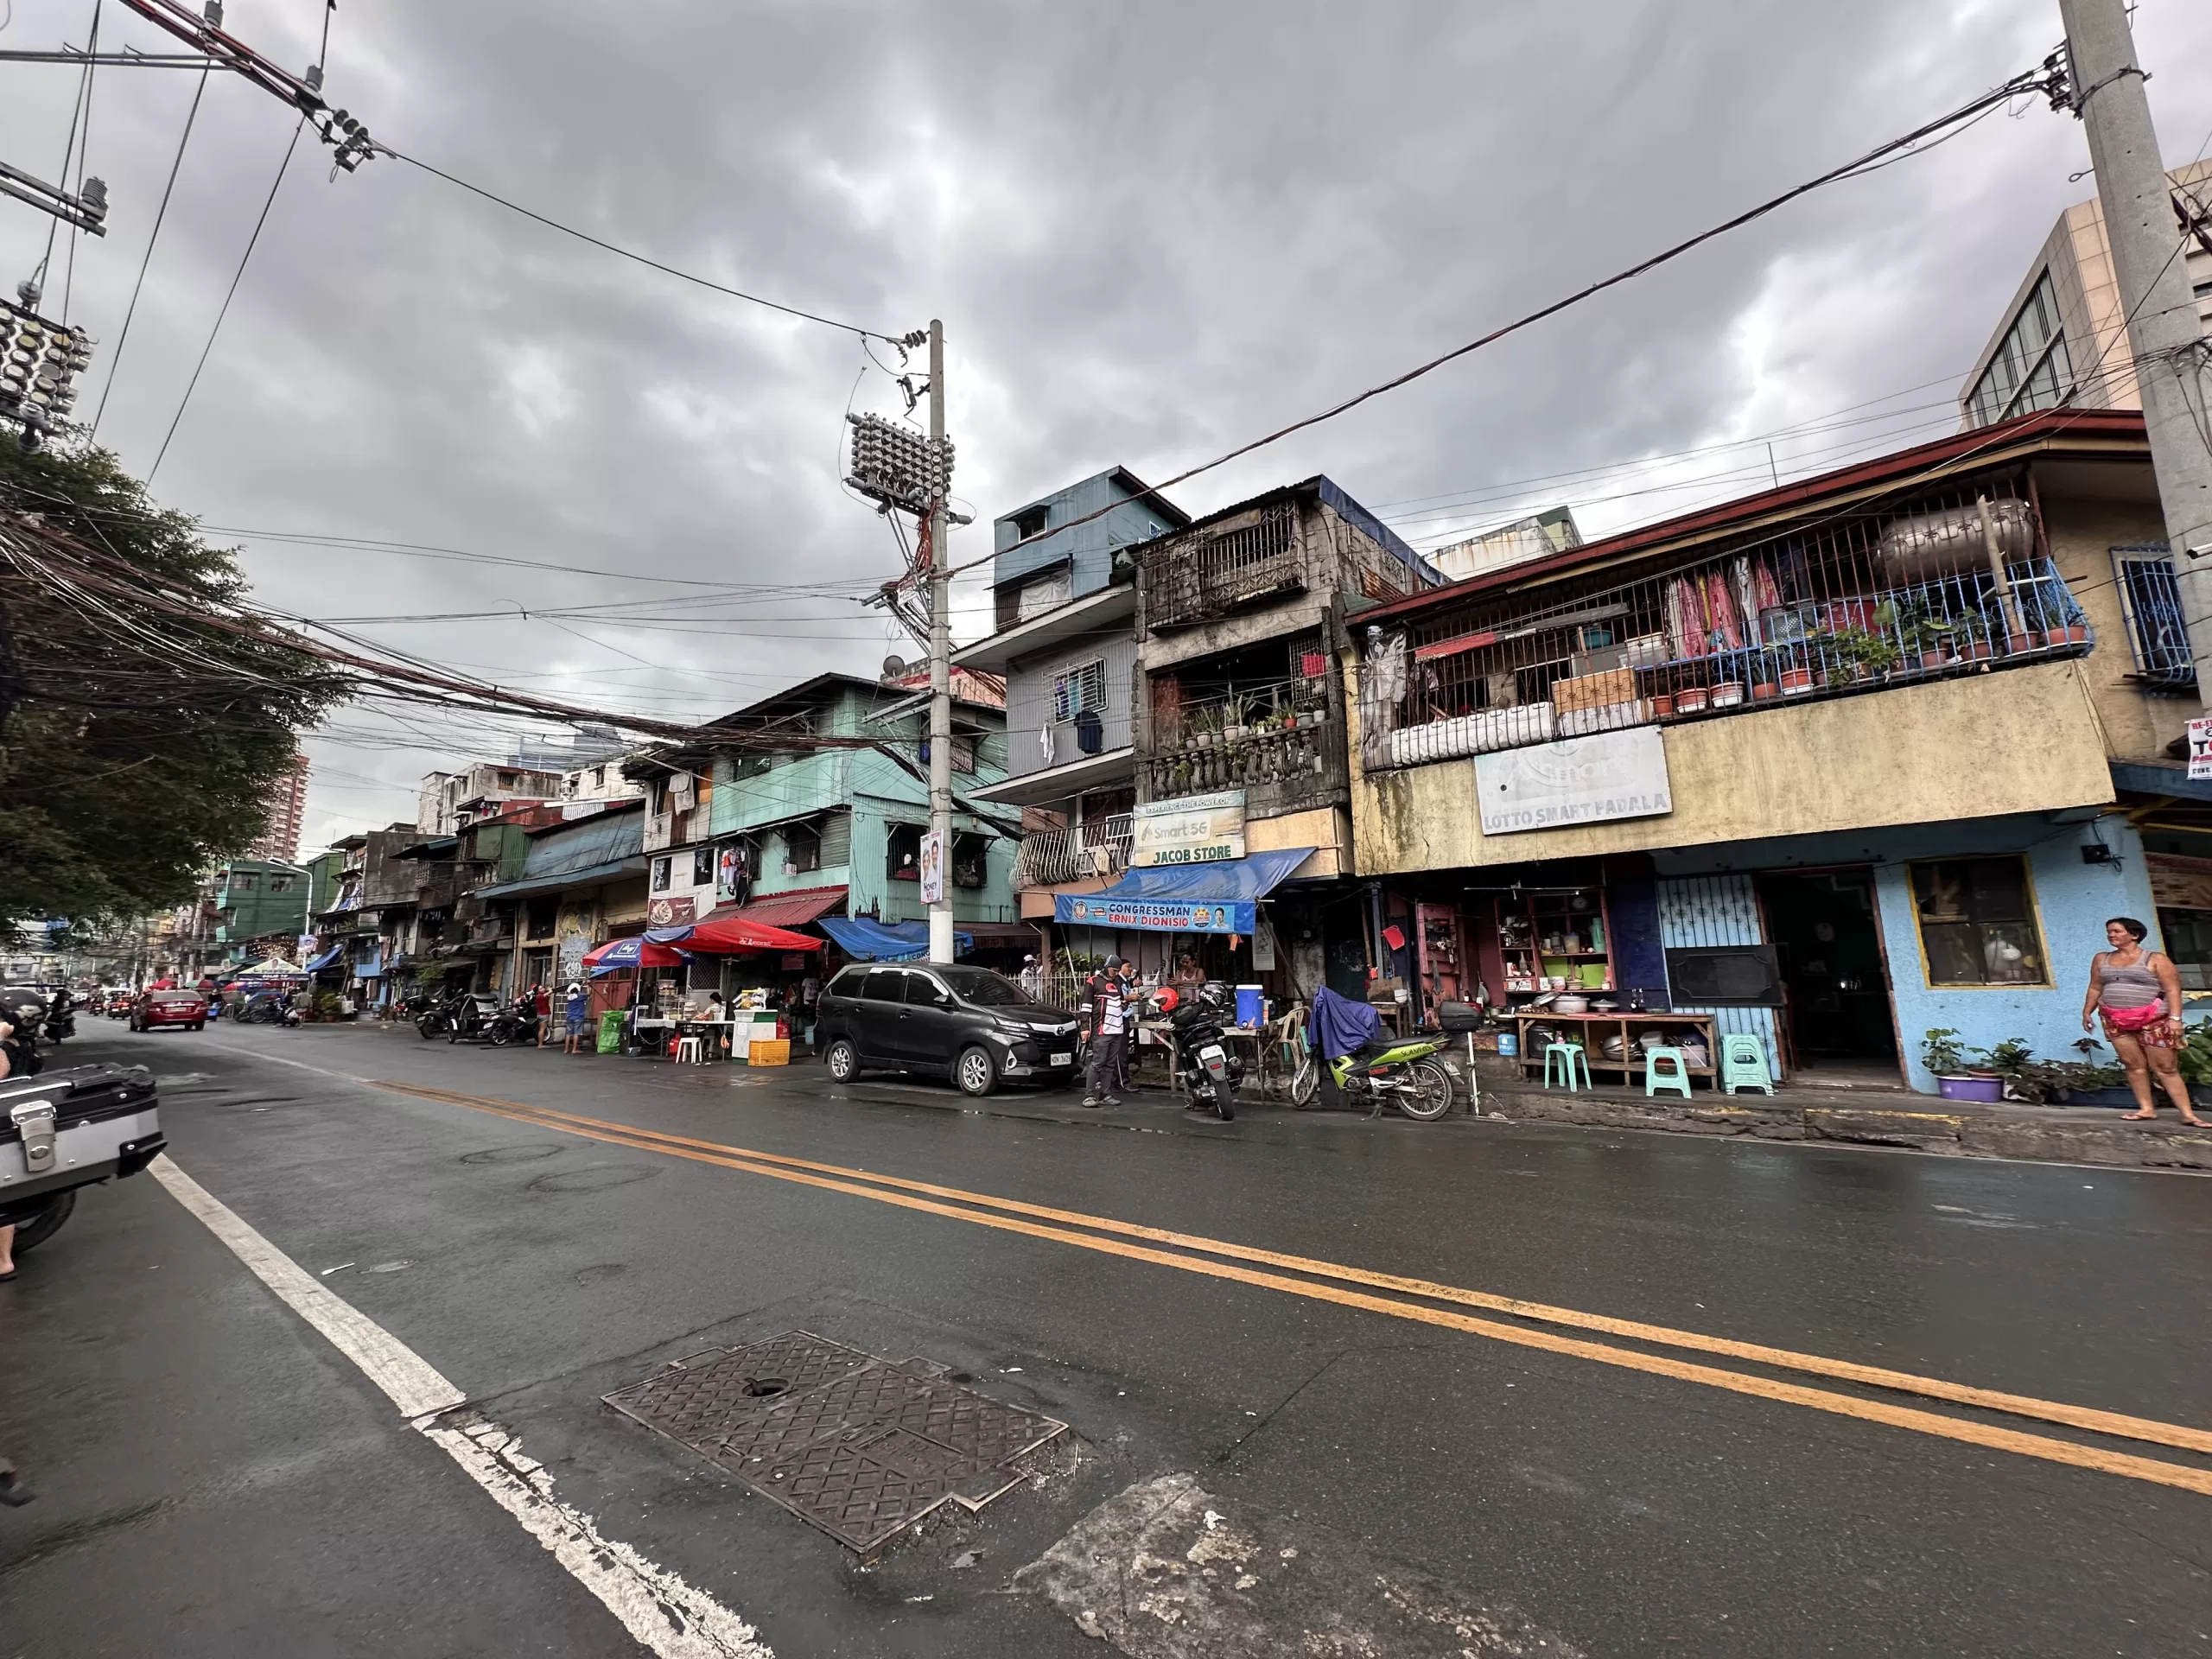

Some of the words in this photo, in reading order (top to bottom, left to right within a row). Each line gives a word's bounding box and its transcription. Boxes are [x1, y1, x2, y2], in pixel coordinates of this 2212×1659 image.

[1147, 803, 1181, 814] EXPERIENCE
[1196, 798, 1219, 807] POWER
[1484, 811, 1532, 830] LOTTO
[1154, 823, 1188, 839] Smart
[1190, 821, 1208, 835] 5G
[1154, 849, 1192, 864] JACOB
[1193, 845, 1231, 857] STORE
[1109, 904, 1191, 917] CONGRESSMAN
[1109, 913, 1138, 925] ERNIX
[1141, 915, 1189, 927] DIONISIO
